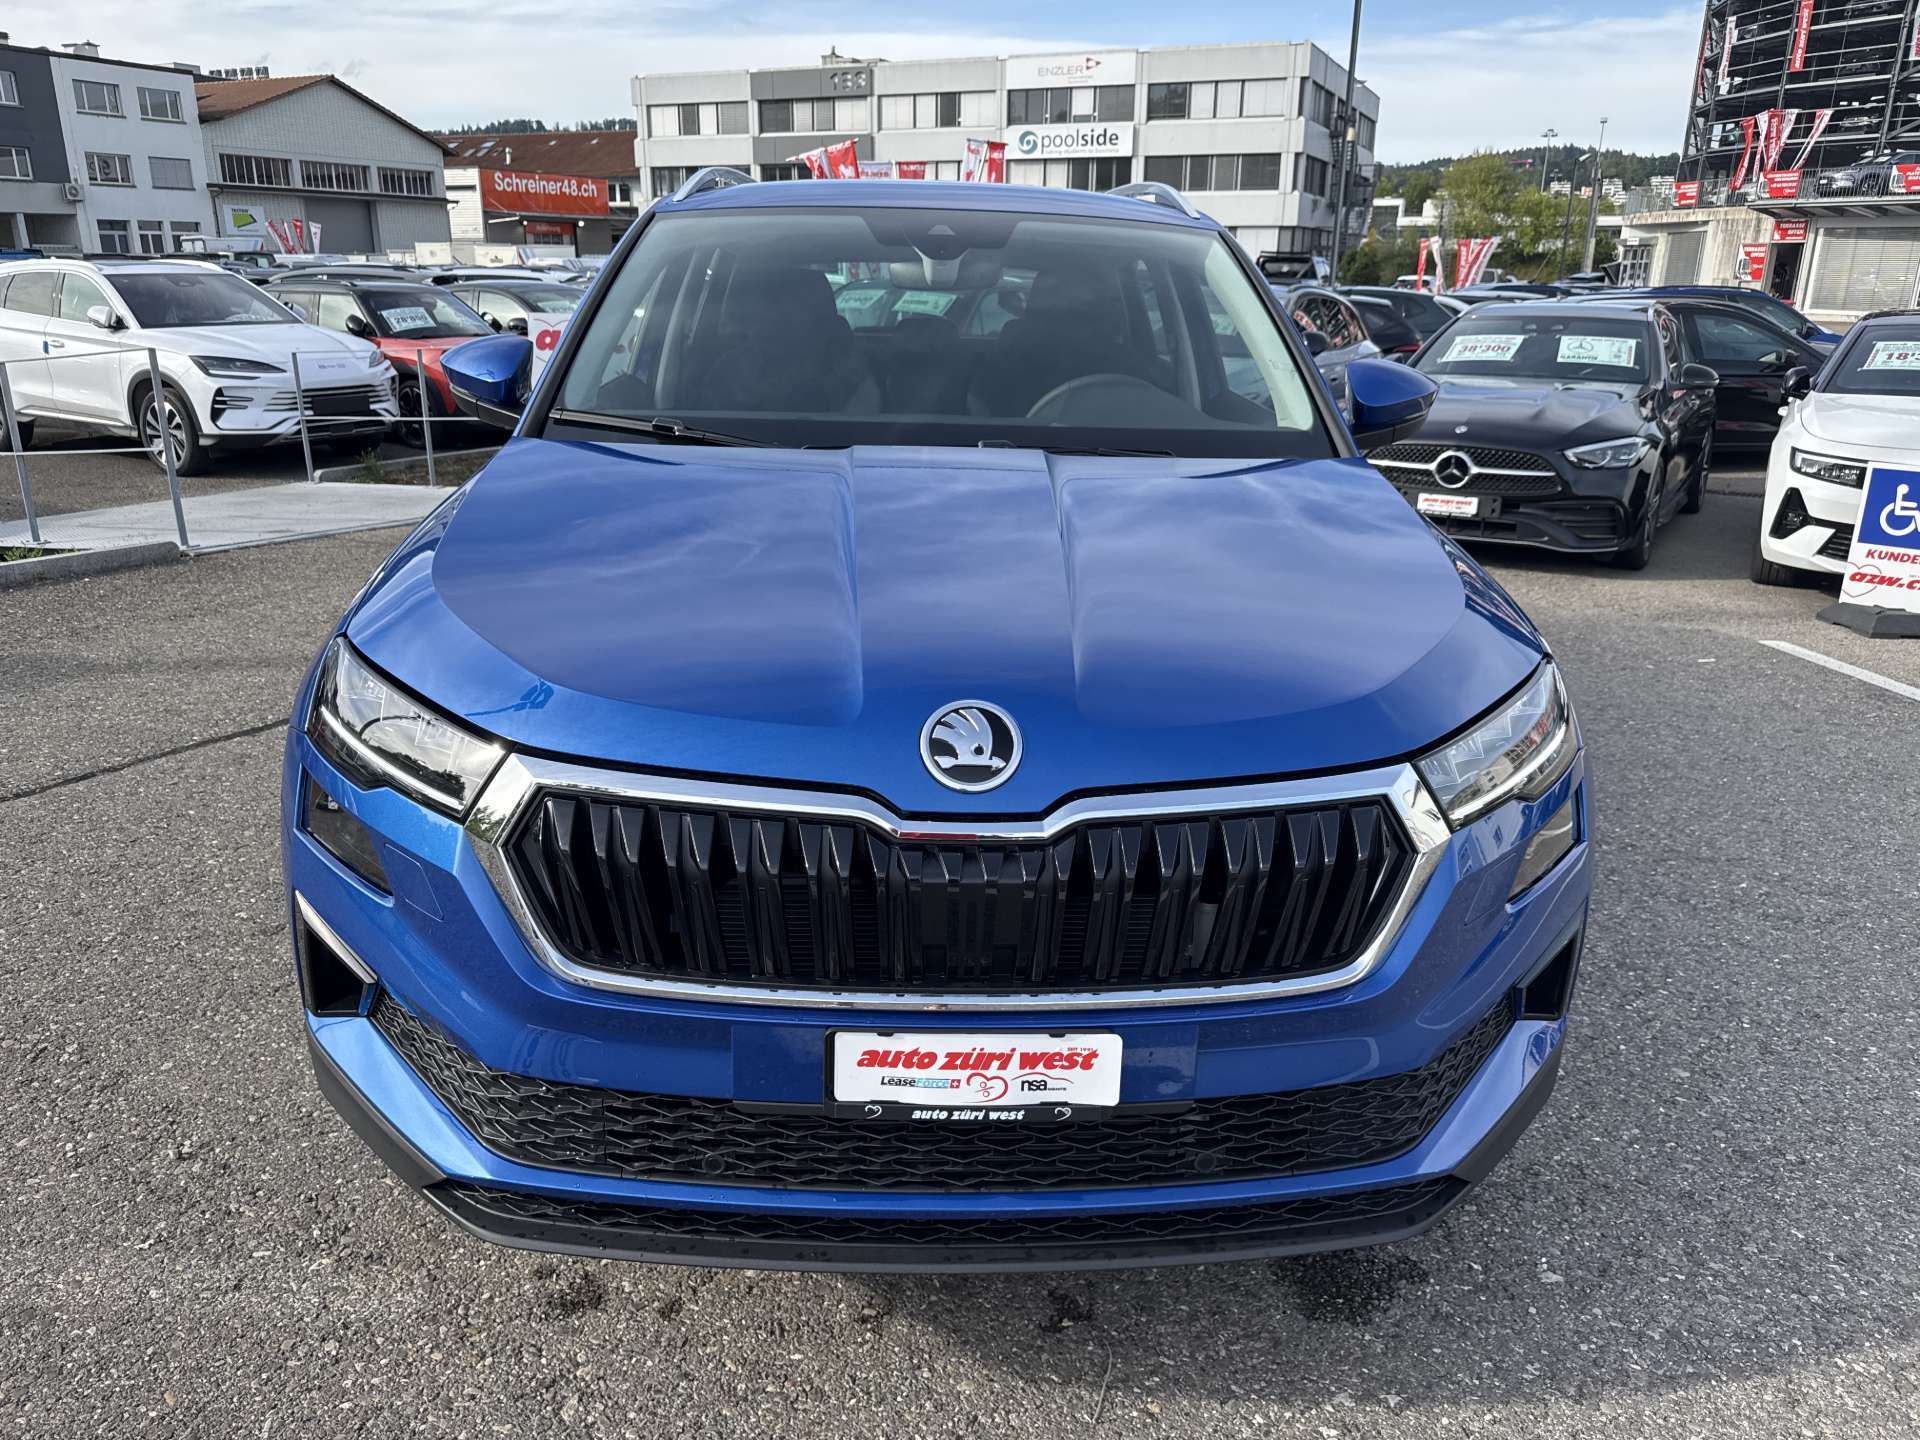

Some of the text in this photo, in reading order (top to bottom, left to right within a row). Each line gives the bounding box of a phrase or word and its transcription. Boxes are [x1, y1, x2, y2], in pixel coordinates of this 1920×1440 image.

[1038, 65, 1084, 77] ENZLER
[1041, 127, 1119, 154] poolside
[494, 171, 598, 198] Schreiner48.ch
[1865, 548, 1920, 565] KUNDE
[1849, 571, 1920, 591] azw.c
[857, 1046, 1100, 1071] auto züri west
[880, 1075, 949, 1088] LeaseForce
[1020, 1079, 1047, 1091] nsa
[911, 1108, 1026, 1120] auto züri west
